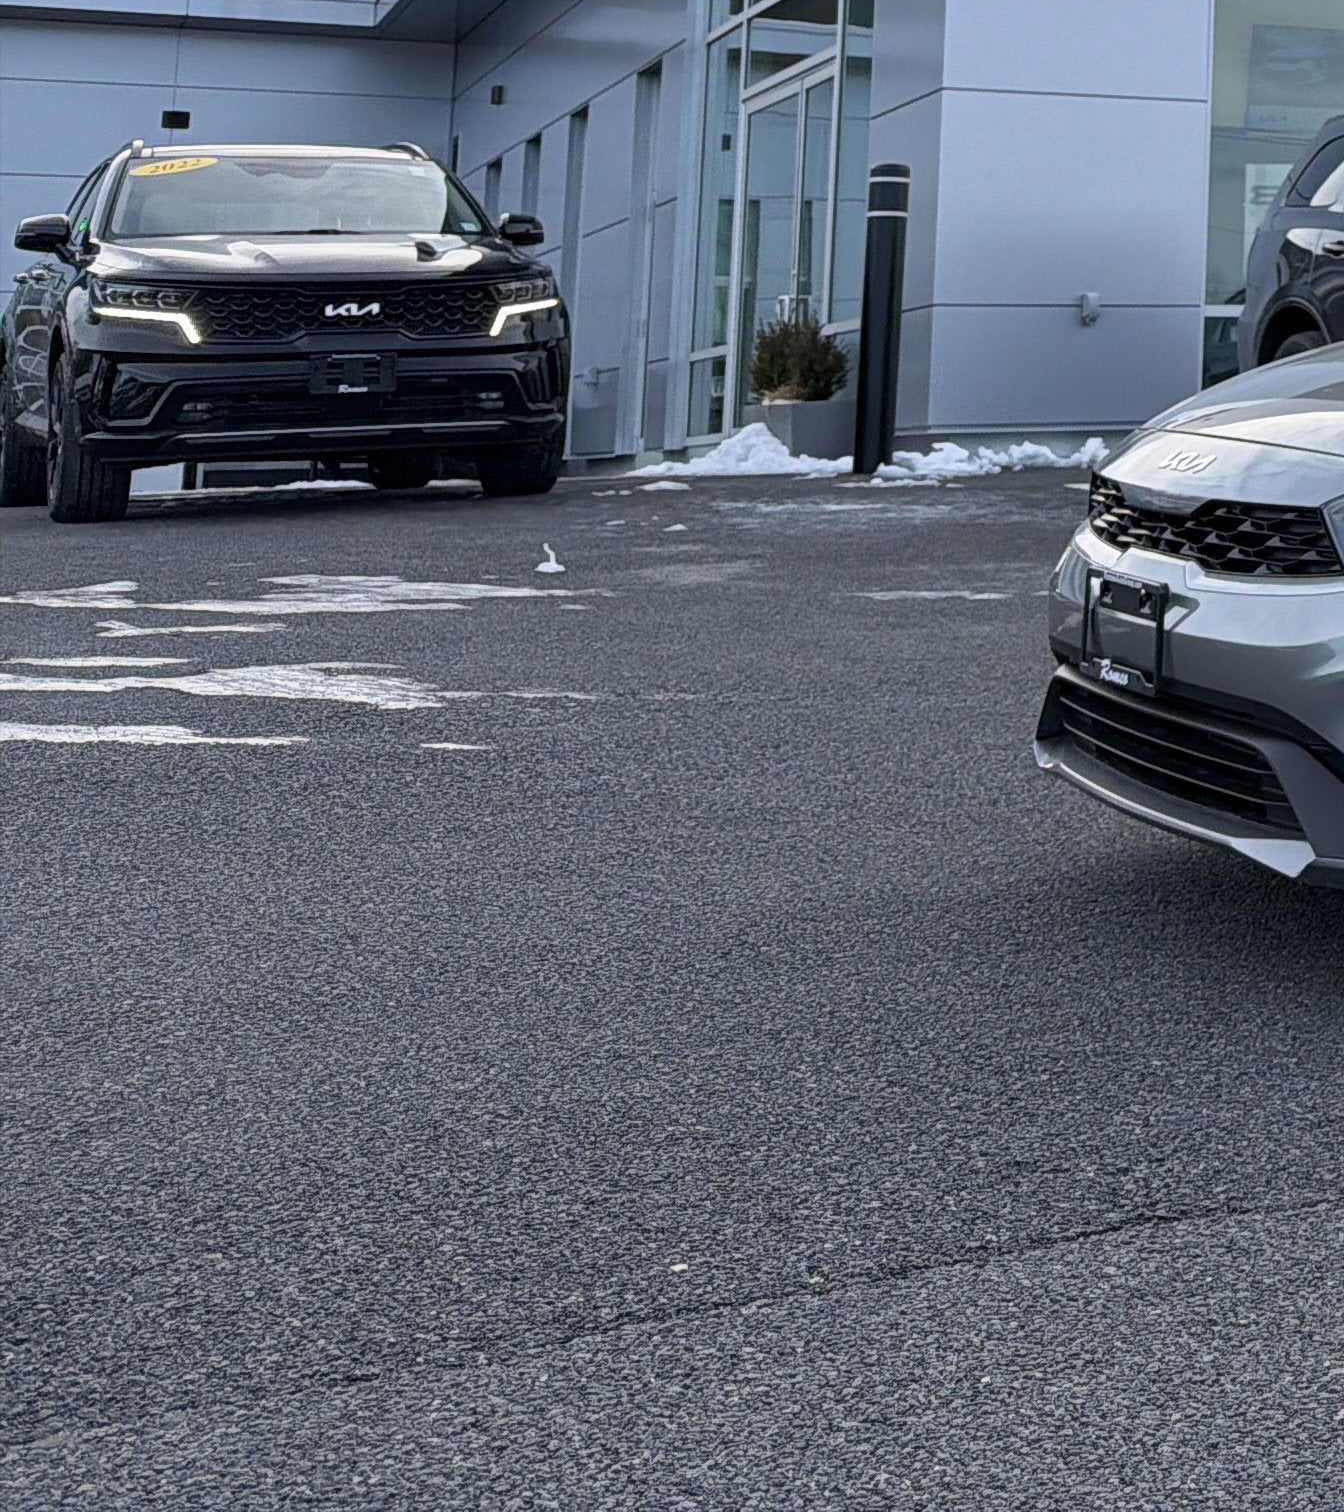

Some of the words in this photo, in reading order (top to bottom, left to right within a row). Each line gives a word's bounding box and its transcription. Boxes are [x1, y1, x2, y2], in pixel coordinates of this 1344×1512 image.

[149, 159, 202, 174] 2022
[324, 302, 380, 316] KIA
[1158, 451, 1218, 475] KIA
